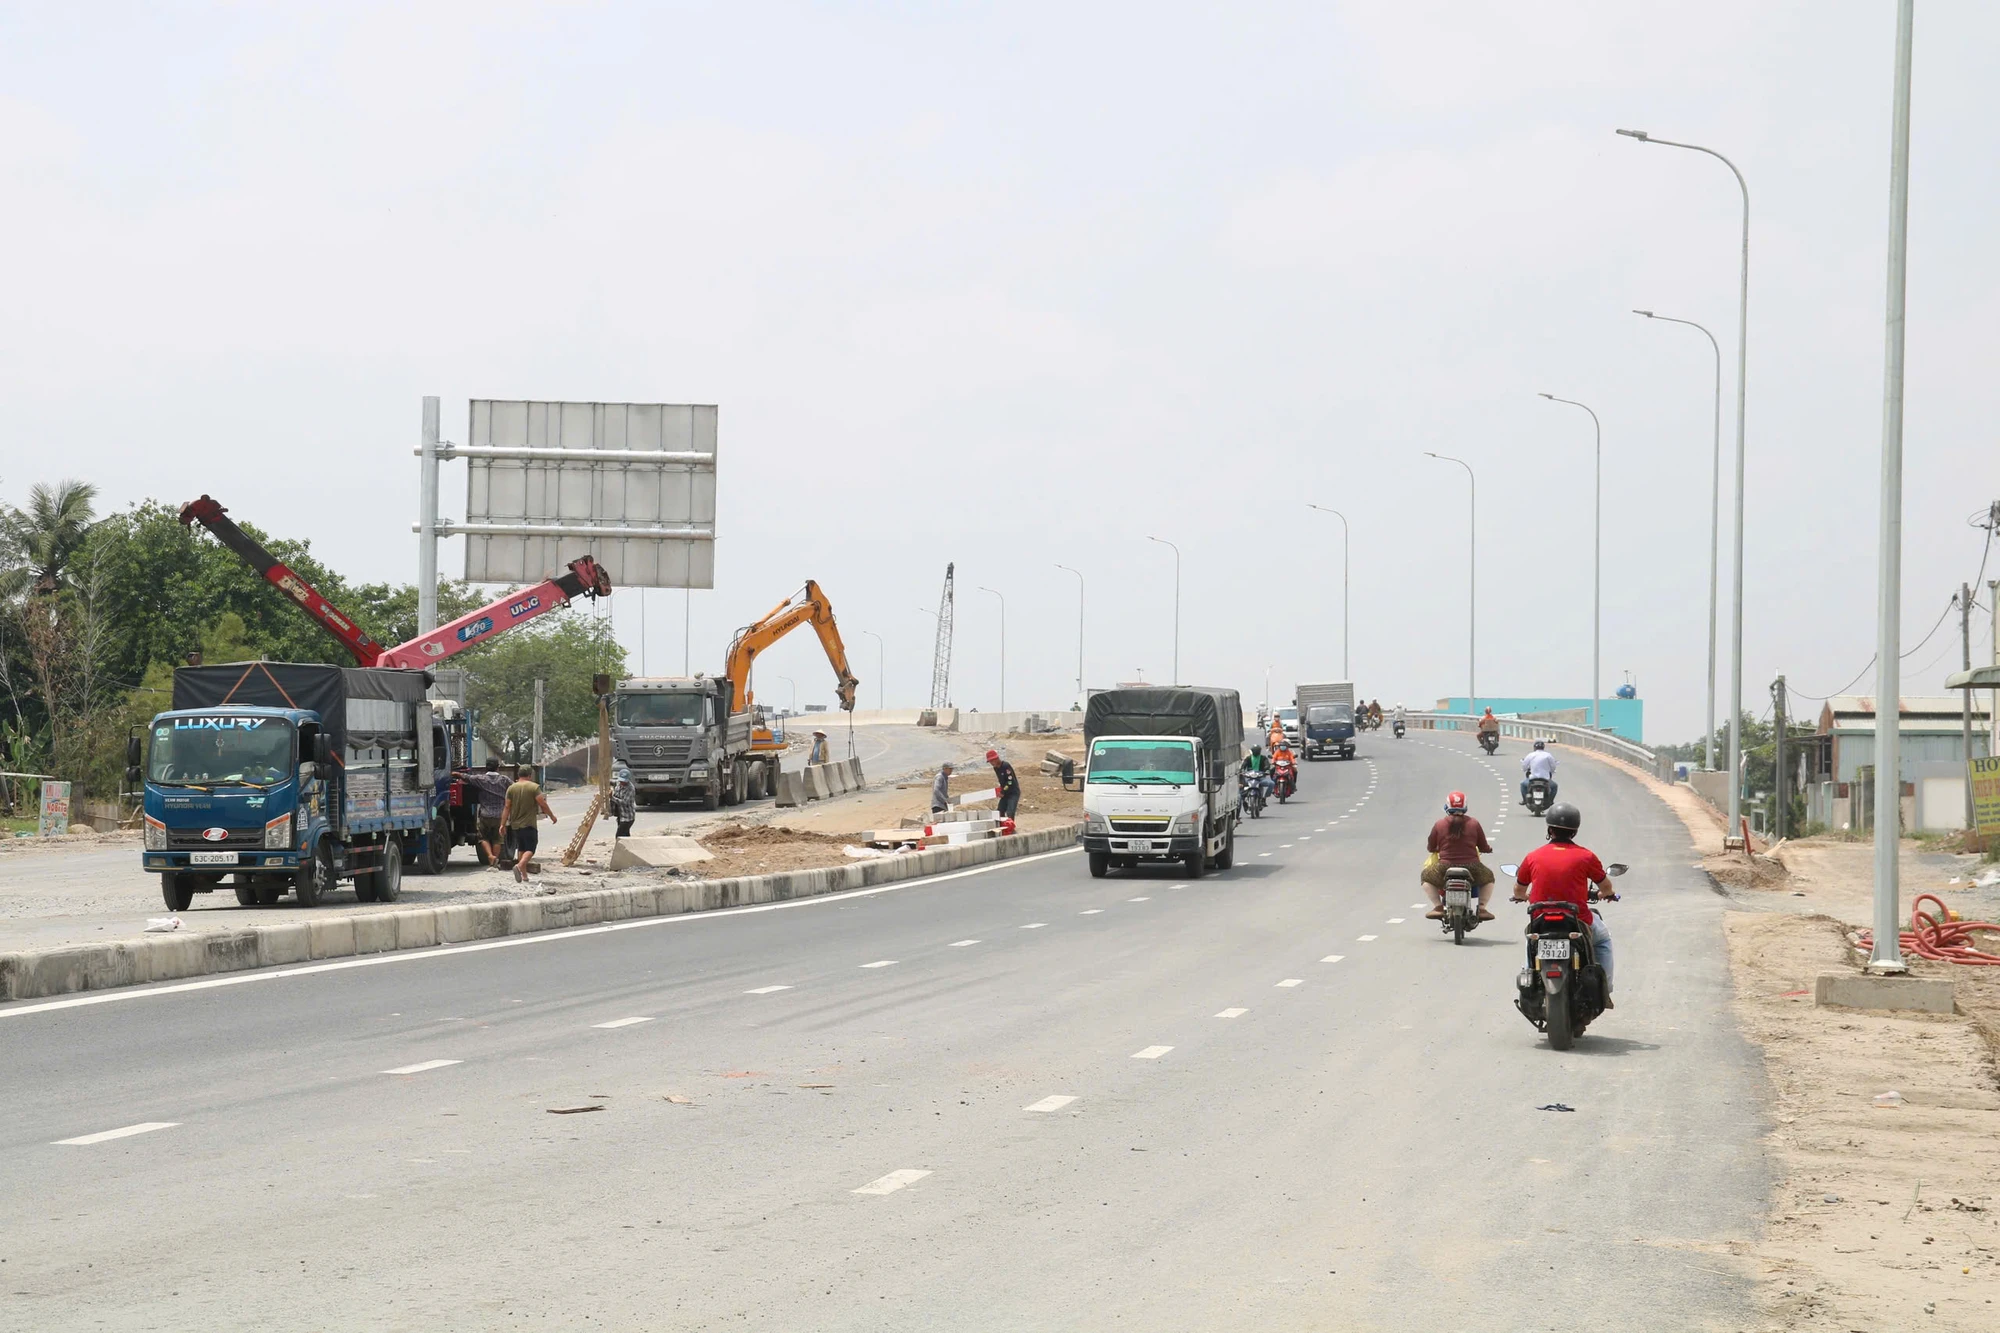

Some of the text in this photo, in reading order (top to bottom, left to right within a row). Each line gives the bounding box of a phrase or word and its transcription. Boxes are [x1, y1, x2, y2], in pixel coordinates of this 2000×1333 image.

[772, 615, 800, 636] HYUNDAI
[174, 717, 267, 731] LUXURY
[1975, 759, 2000, 772] HO
[194, 855, 235, 863] 63C-205.17
